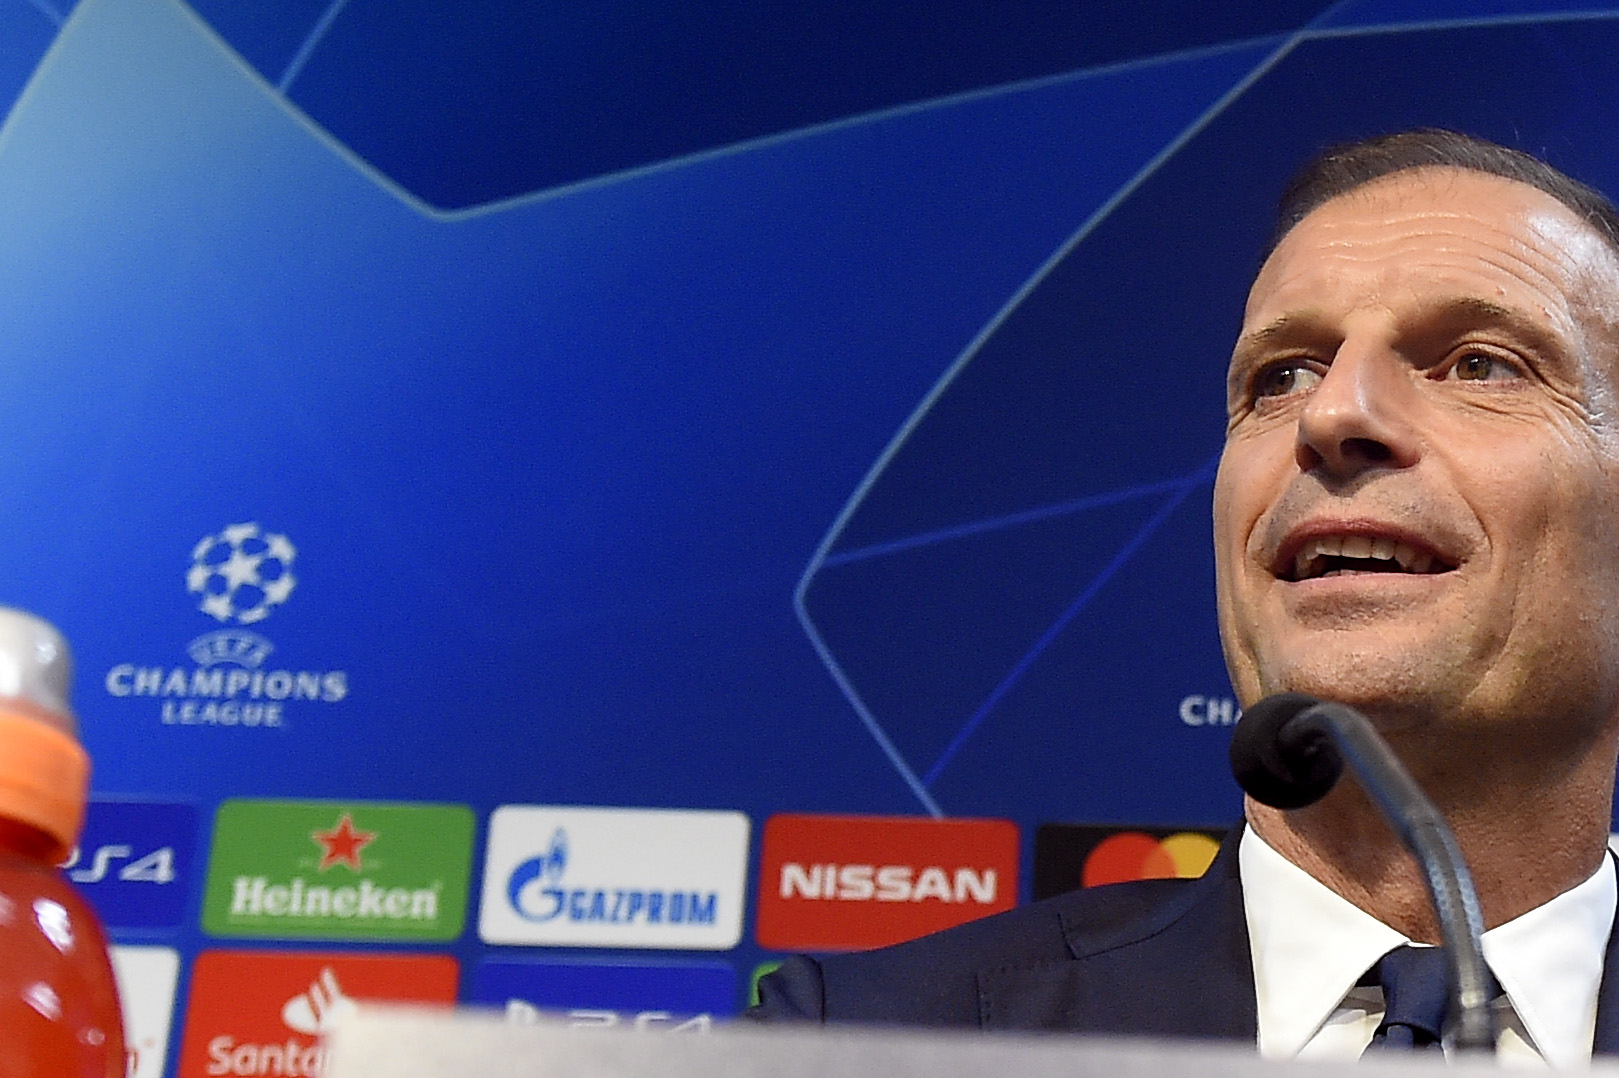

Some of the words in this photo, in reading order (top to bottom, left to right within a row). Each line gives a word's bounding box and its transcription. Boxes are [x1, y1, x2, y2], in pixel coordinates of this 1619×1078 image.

[105, 663, 347, 703] CHAMPIONS
[161, 700, 282, 727] LEAGUE
[1180, 694, 1243, 727] CH
[230, 875, 438, 921] Heineken
[780, 863, 998, 904] NISSAN
[566, 885, 720, 927] GAZPROM
[206, 1034, 330, 1077] Santa
